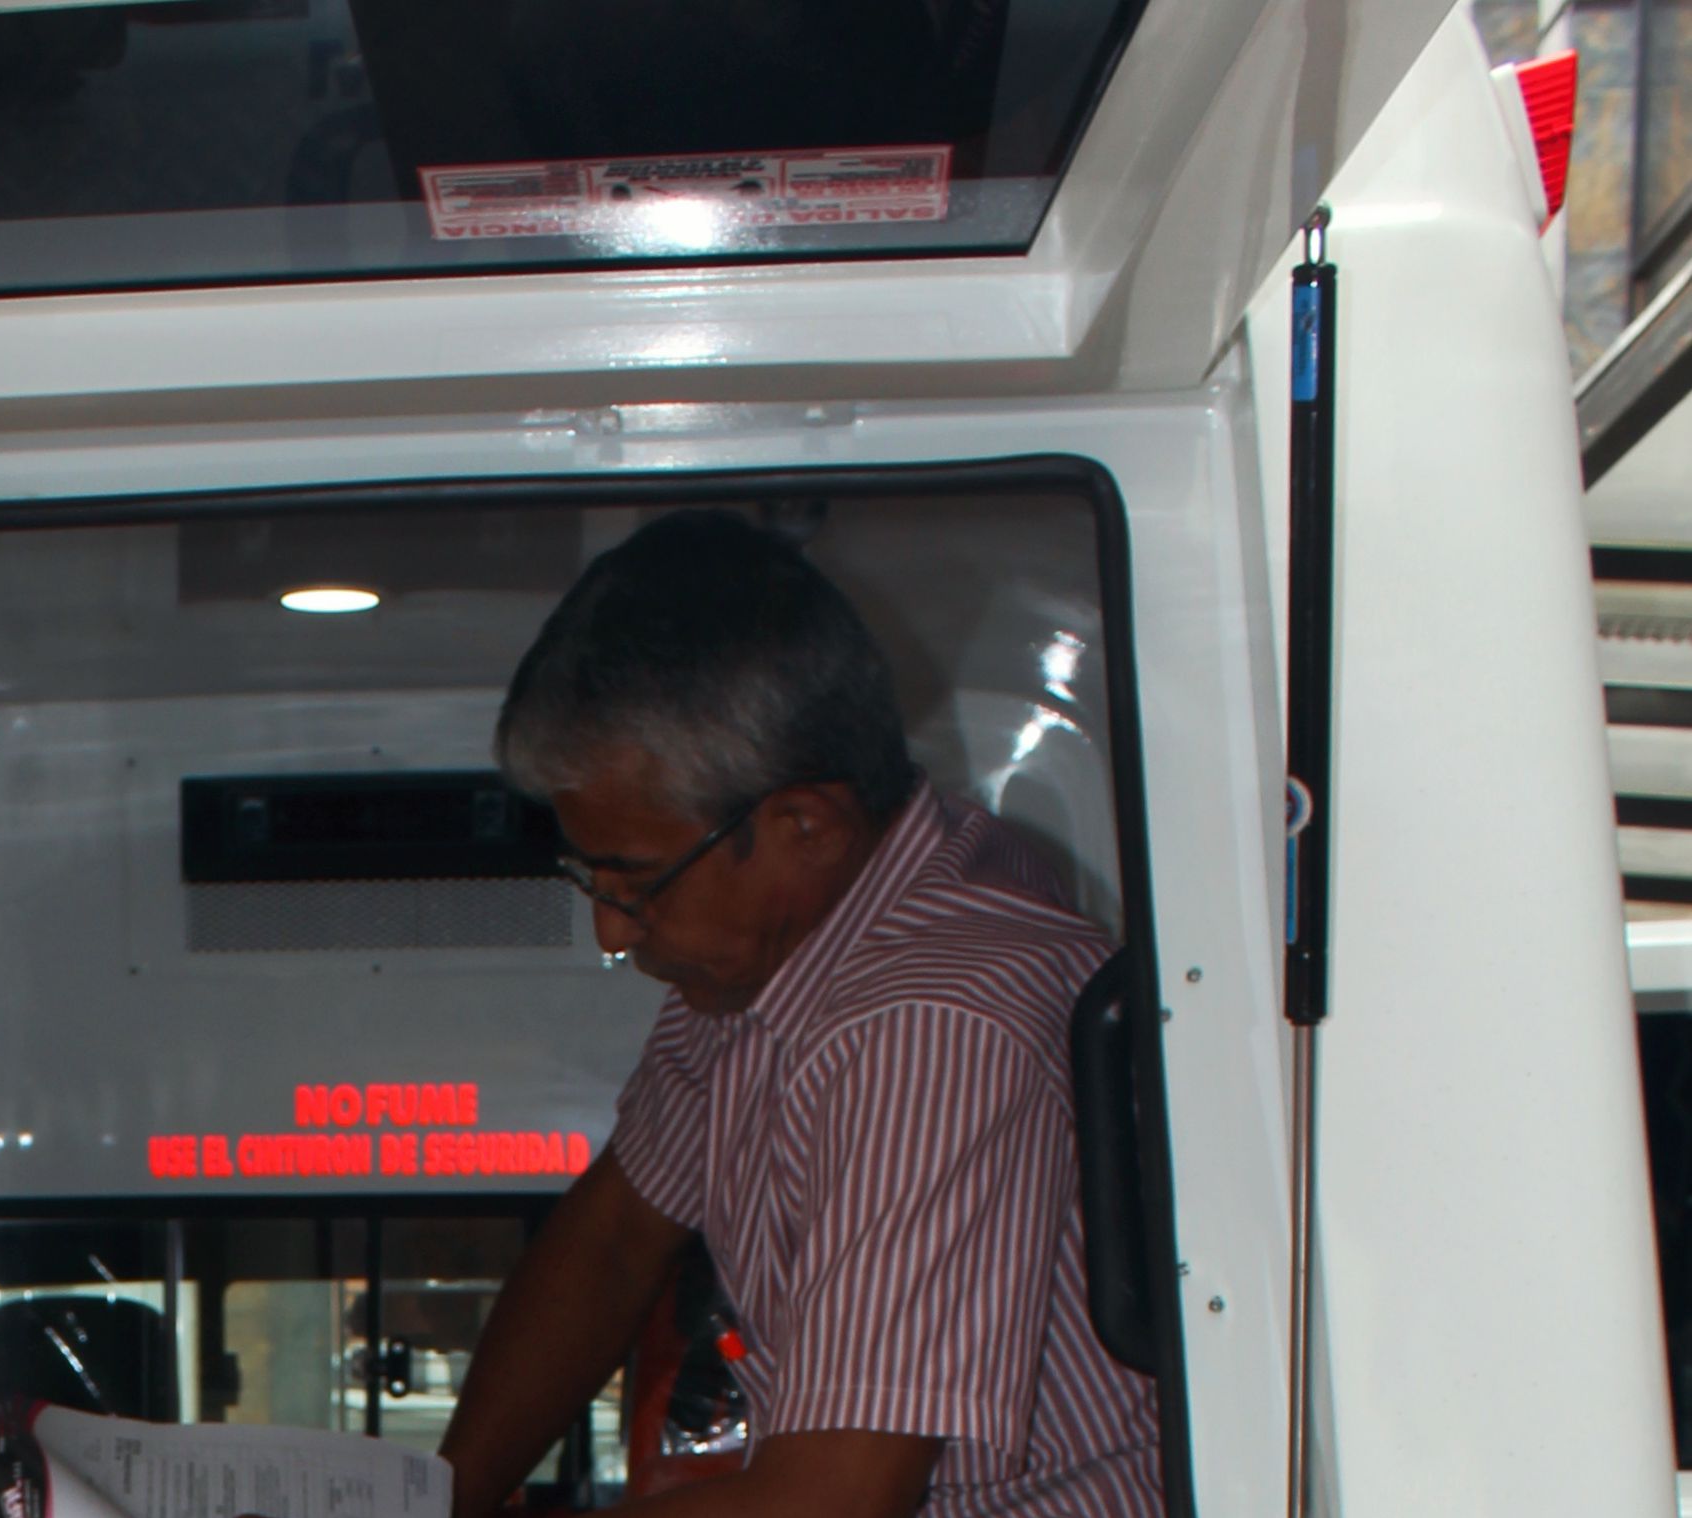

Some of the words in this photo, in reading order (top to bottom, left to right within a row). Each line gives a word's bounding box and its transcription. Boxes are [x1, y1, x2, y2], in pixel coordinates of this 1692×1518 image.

[295, 1084, 362, 1127] NO
[365, 1082, 479, 1127] FUME
[148, 1134, 198, 1178] USE
[202, 1134, 234, 1177] EL
[379, 1132, 419, 1176] DE
[423, 1131, 591, 1175] SEGURIDAD
